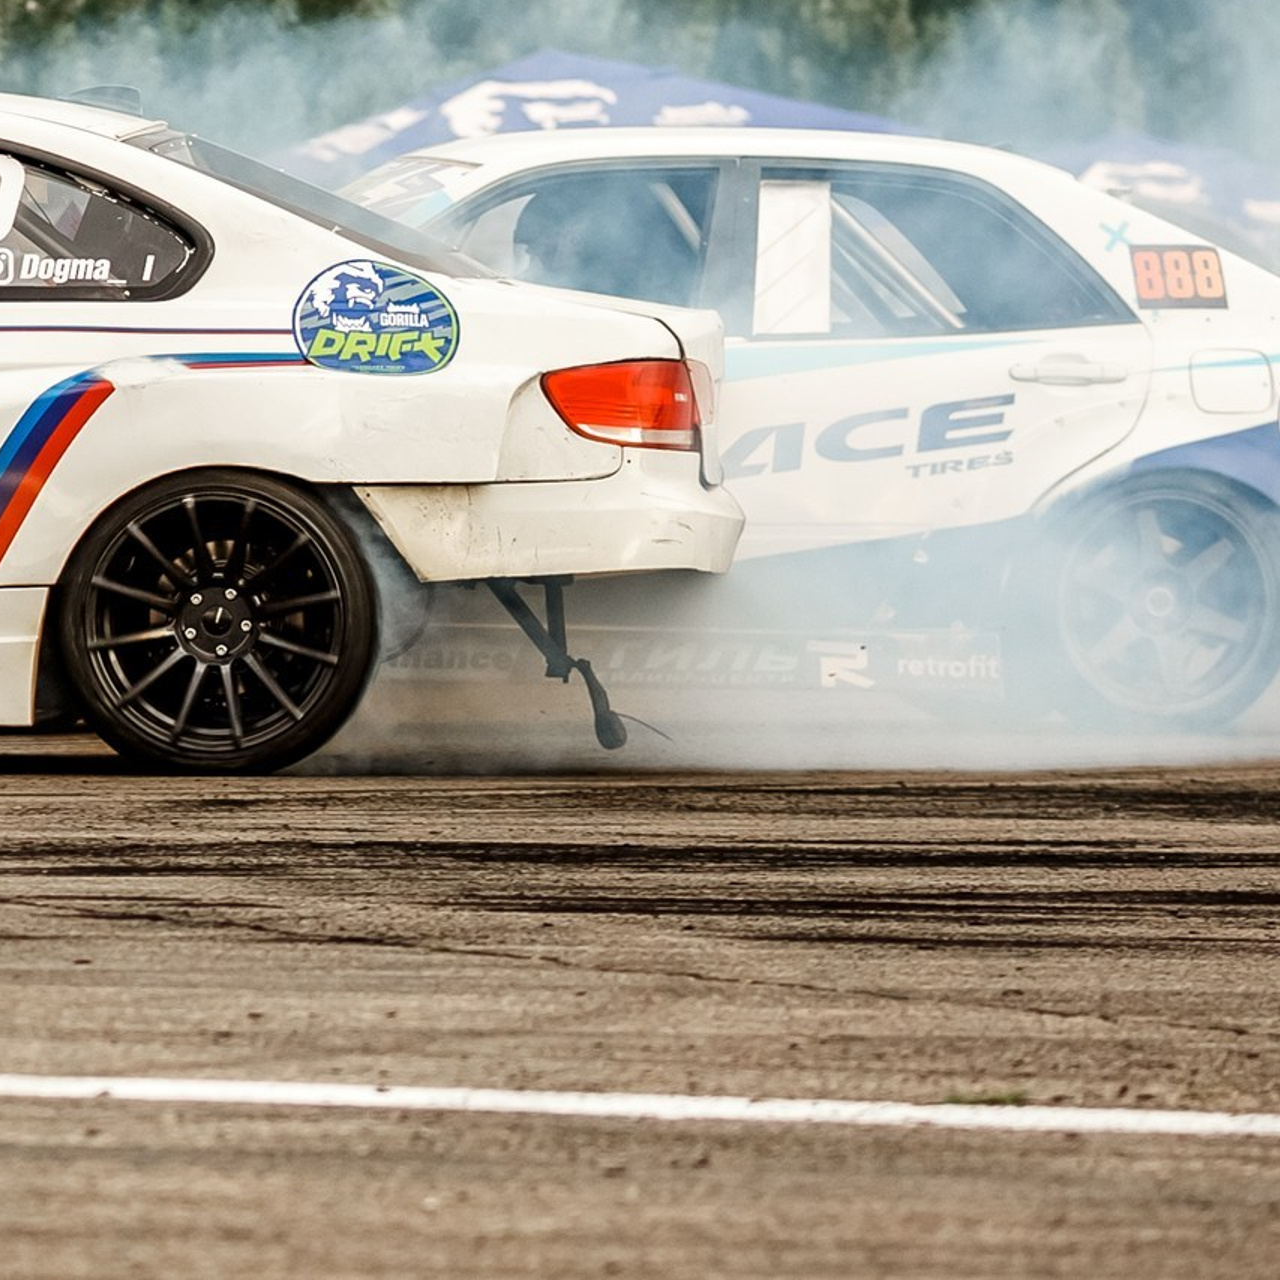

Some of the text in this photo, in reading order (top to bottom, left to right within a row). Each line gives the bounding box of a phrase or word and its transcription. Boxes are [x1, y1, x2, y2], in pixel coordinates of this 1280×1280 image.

[1133, 250, 1226, 299] 888
[380, 312, 429, 328] GORILLA
[307, 329, 446, 364] DRIFT
[905, 450, 1014, 479] TIRES
[896, 655, 1001, 679] retrofit
